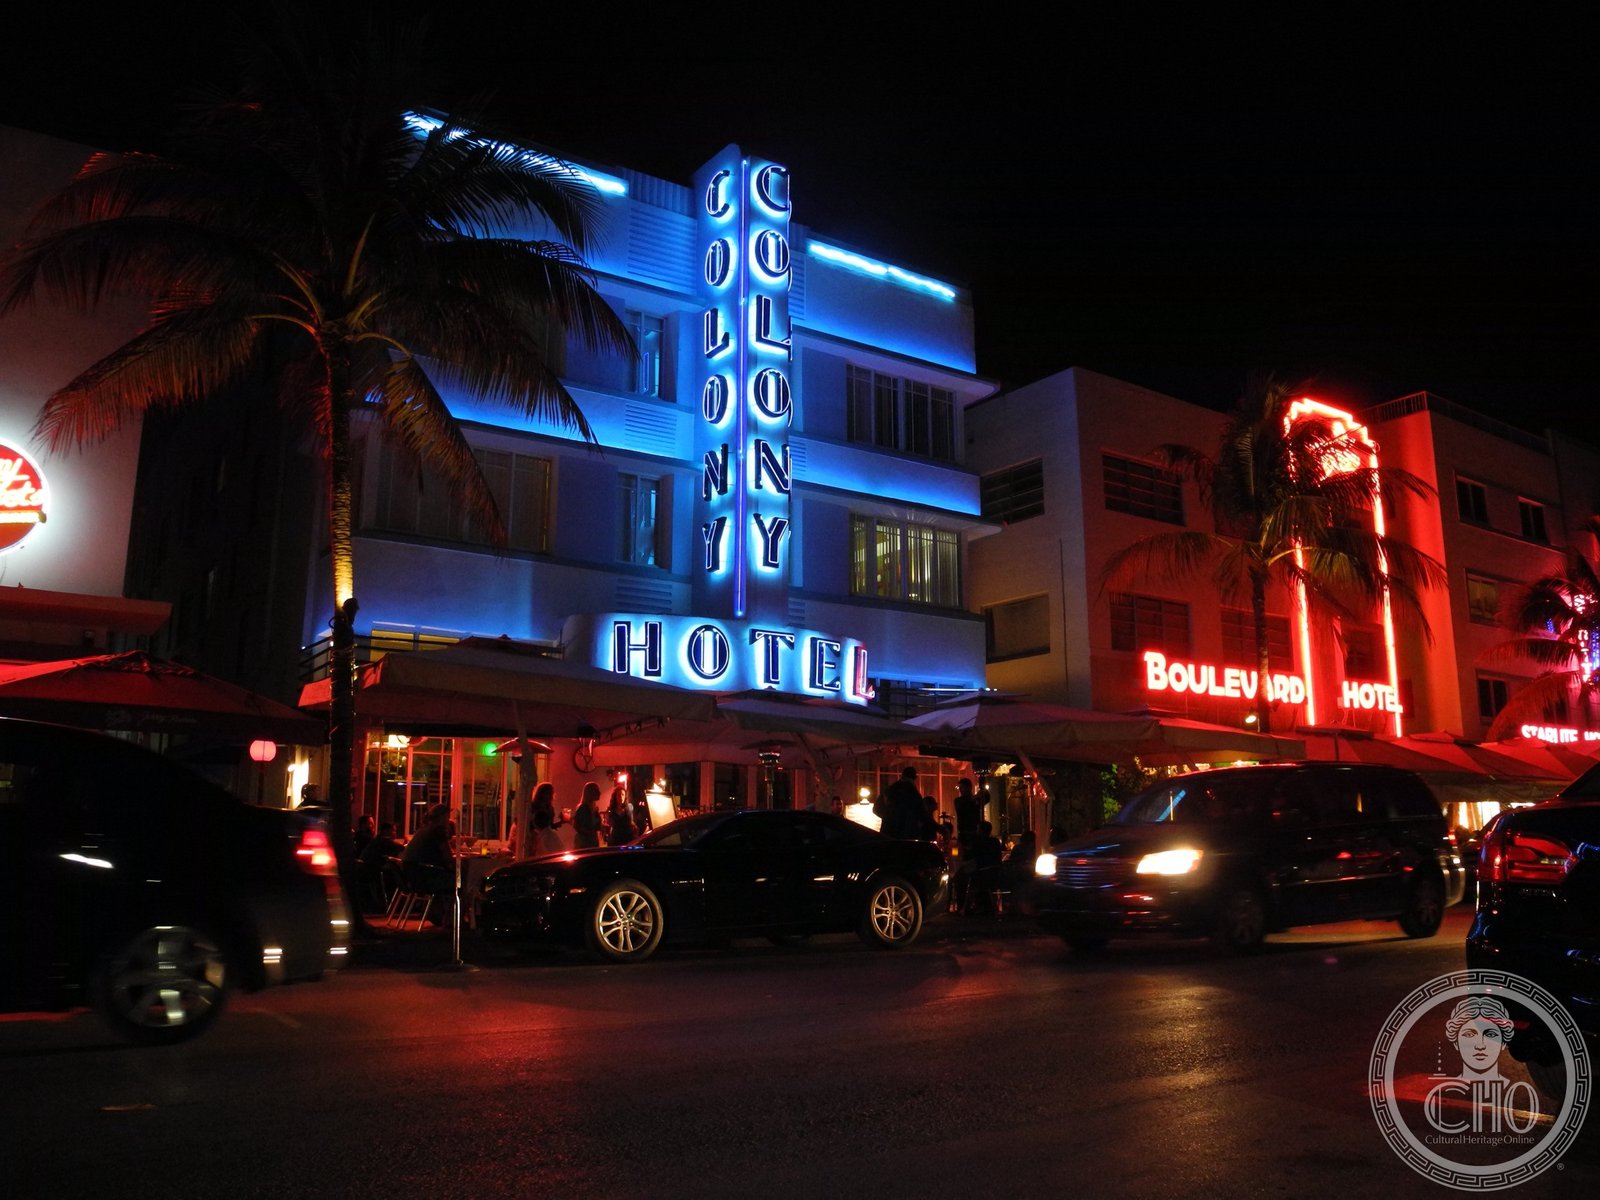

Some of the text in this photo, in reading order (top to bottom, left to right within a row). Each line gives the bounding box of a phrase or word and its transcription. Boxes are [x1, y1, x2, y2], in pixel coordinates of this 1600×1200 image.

[702, 169, 731, 573] COLONY
[753, 165, 792, 569] COLONY
[613, 620, 876, 700] HOTEL
[1342, 680, 1404, 713] HOTEL
